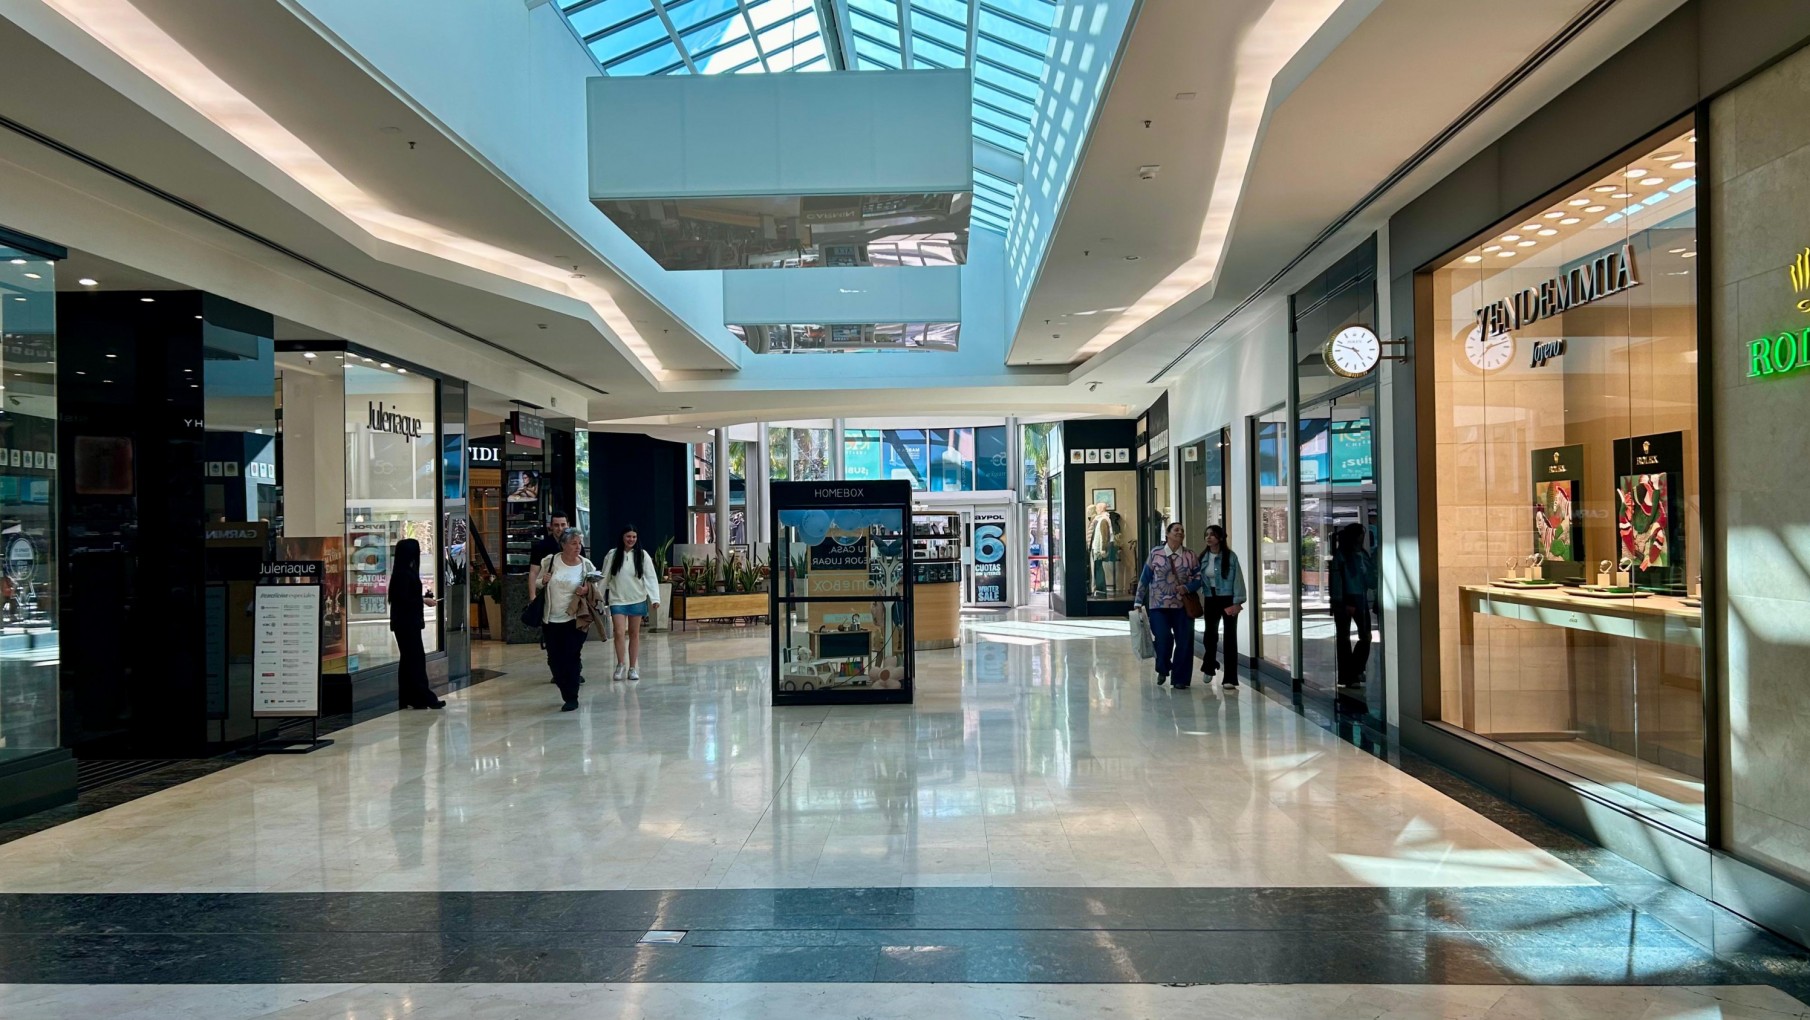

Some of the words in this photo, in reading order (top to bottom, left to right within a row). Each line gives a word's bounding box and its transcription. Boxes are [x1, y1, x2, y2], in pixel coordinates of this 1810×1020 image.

[1475, 244, 1639, 341] VENDEMMIA
[1530, 338, 1566, 368] Joyero
[366, 400, 421, 443] Juleriaque
[1636, 455, 1659, 465] ROLEX
[814, 488, 864, 498] HOMEBOX
[975, 525, 1005, 563] 6
[259, 562, 316, 575] Juleriaque
[975, 563, 1001, 572] CUOTAS
[977, 585, 999, 593] WINTER
[978, 593, 999, 602] SALE
